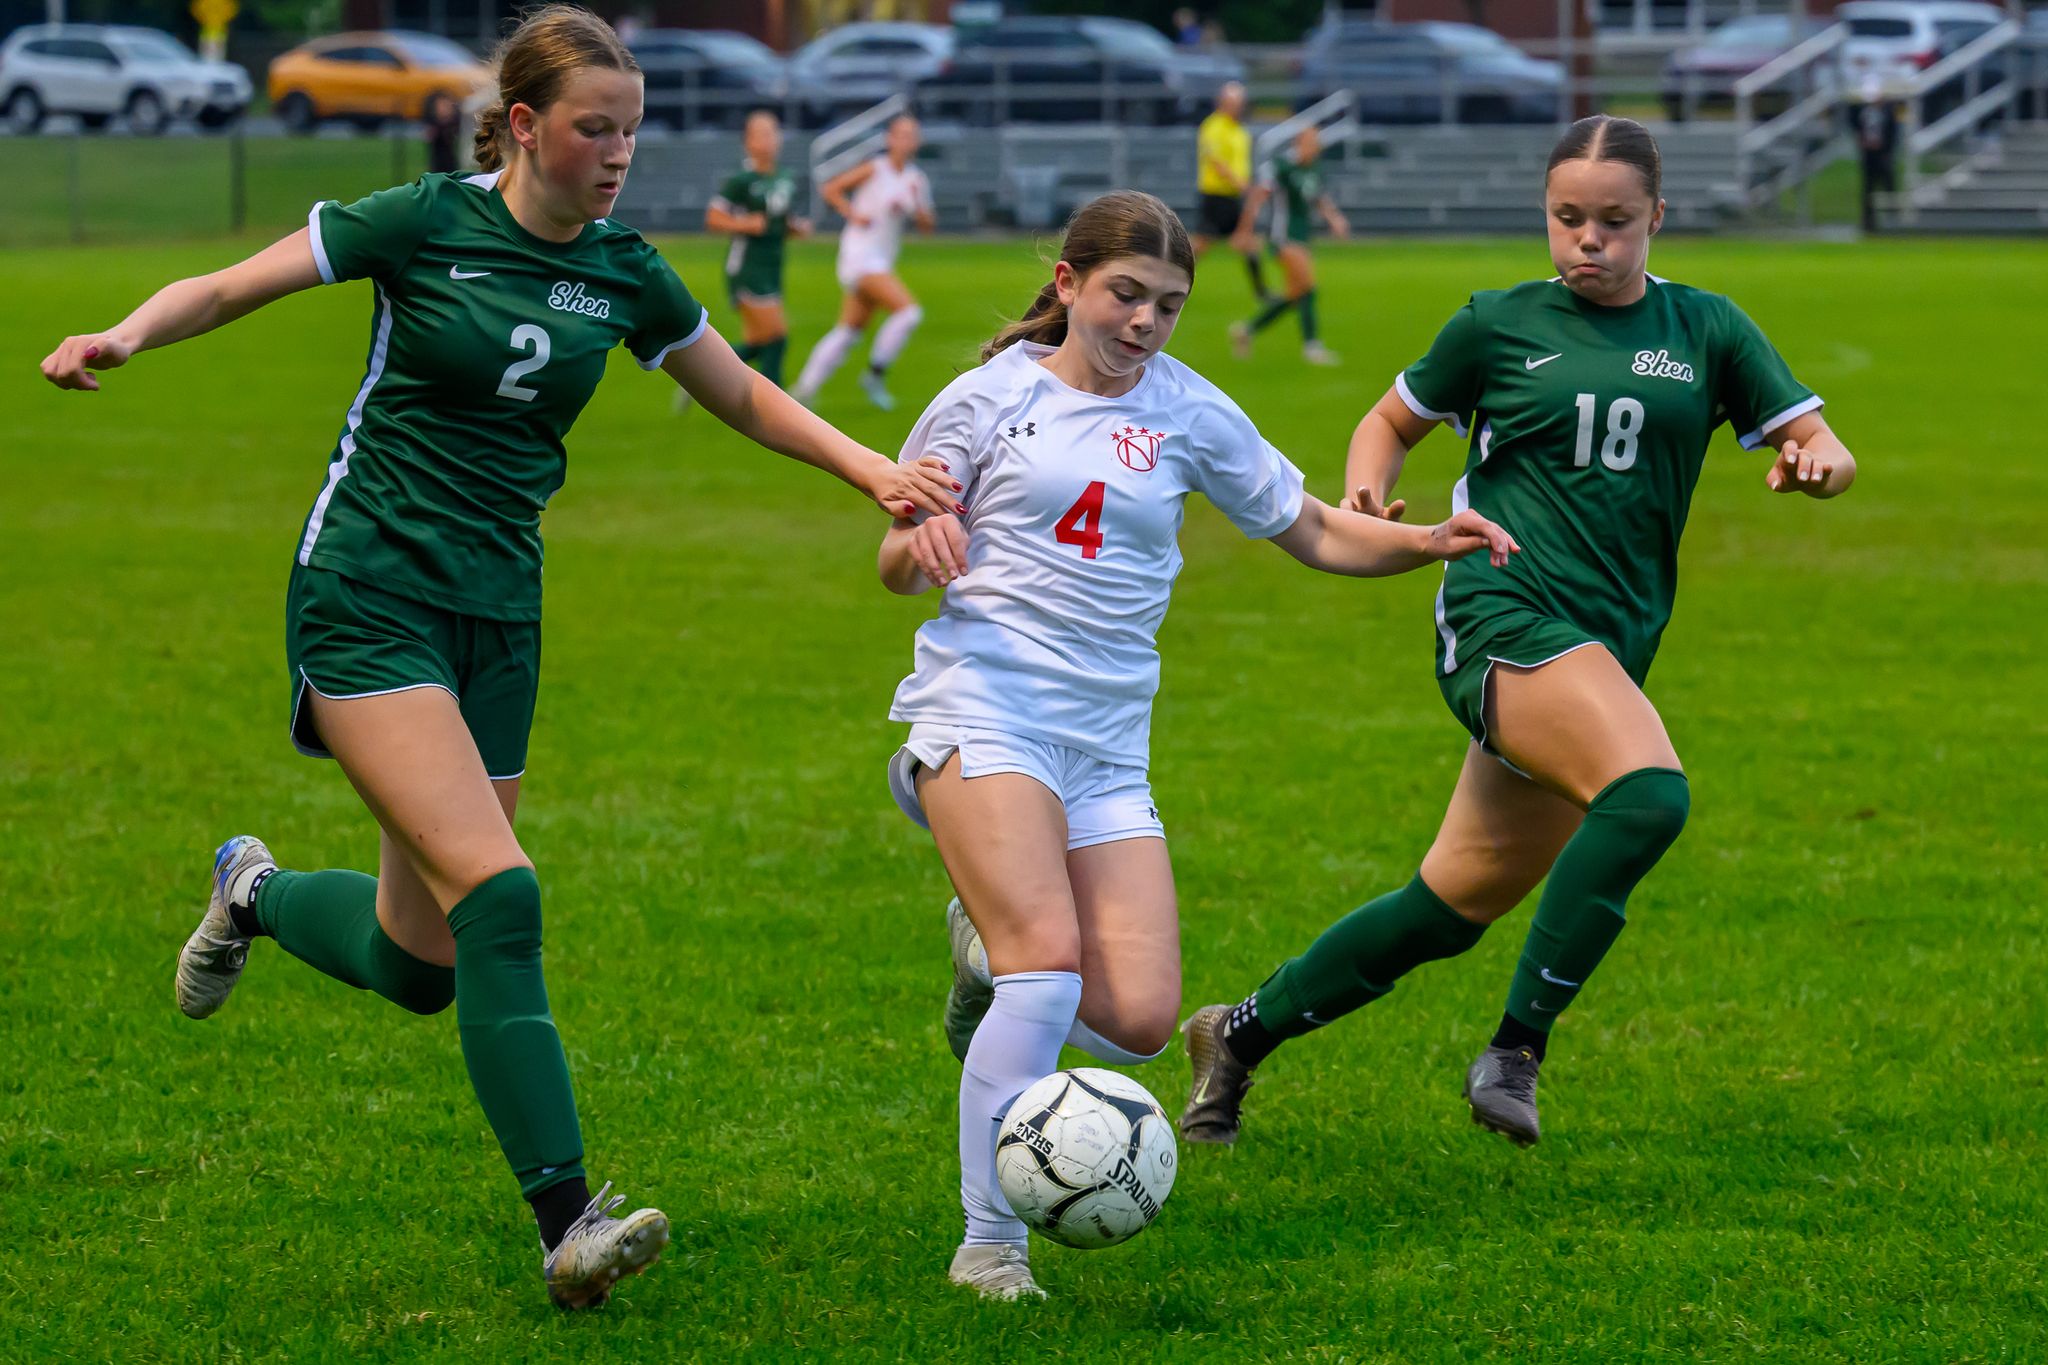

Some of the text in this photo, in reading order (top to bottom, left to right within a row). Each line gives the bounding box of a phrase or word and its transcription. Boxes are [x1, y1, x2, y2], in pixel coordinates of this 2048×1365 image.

[548, 281, 610, 319] Shen
[496, 323, 551, 402] 2
[1632, 349, 1694, 382] Shen
[1573, 392, 1645, 471] 18
[1054, 480, 1106, 560] 4
[1020, 1124, 1054, 1155] NFHS
[1106, 1157, 1160, 1222] SPALDIN
